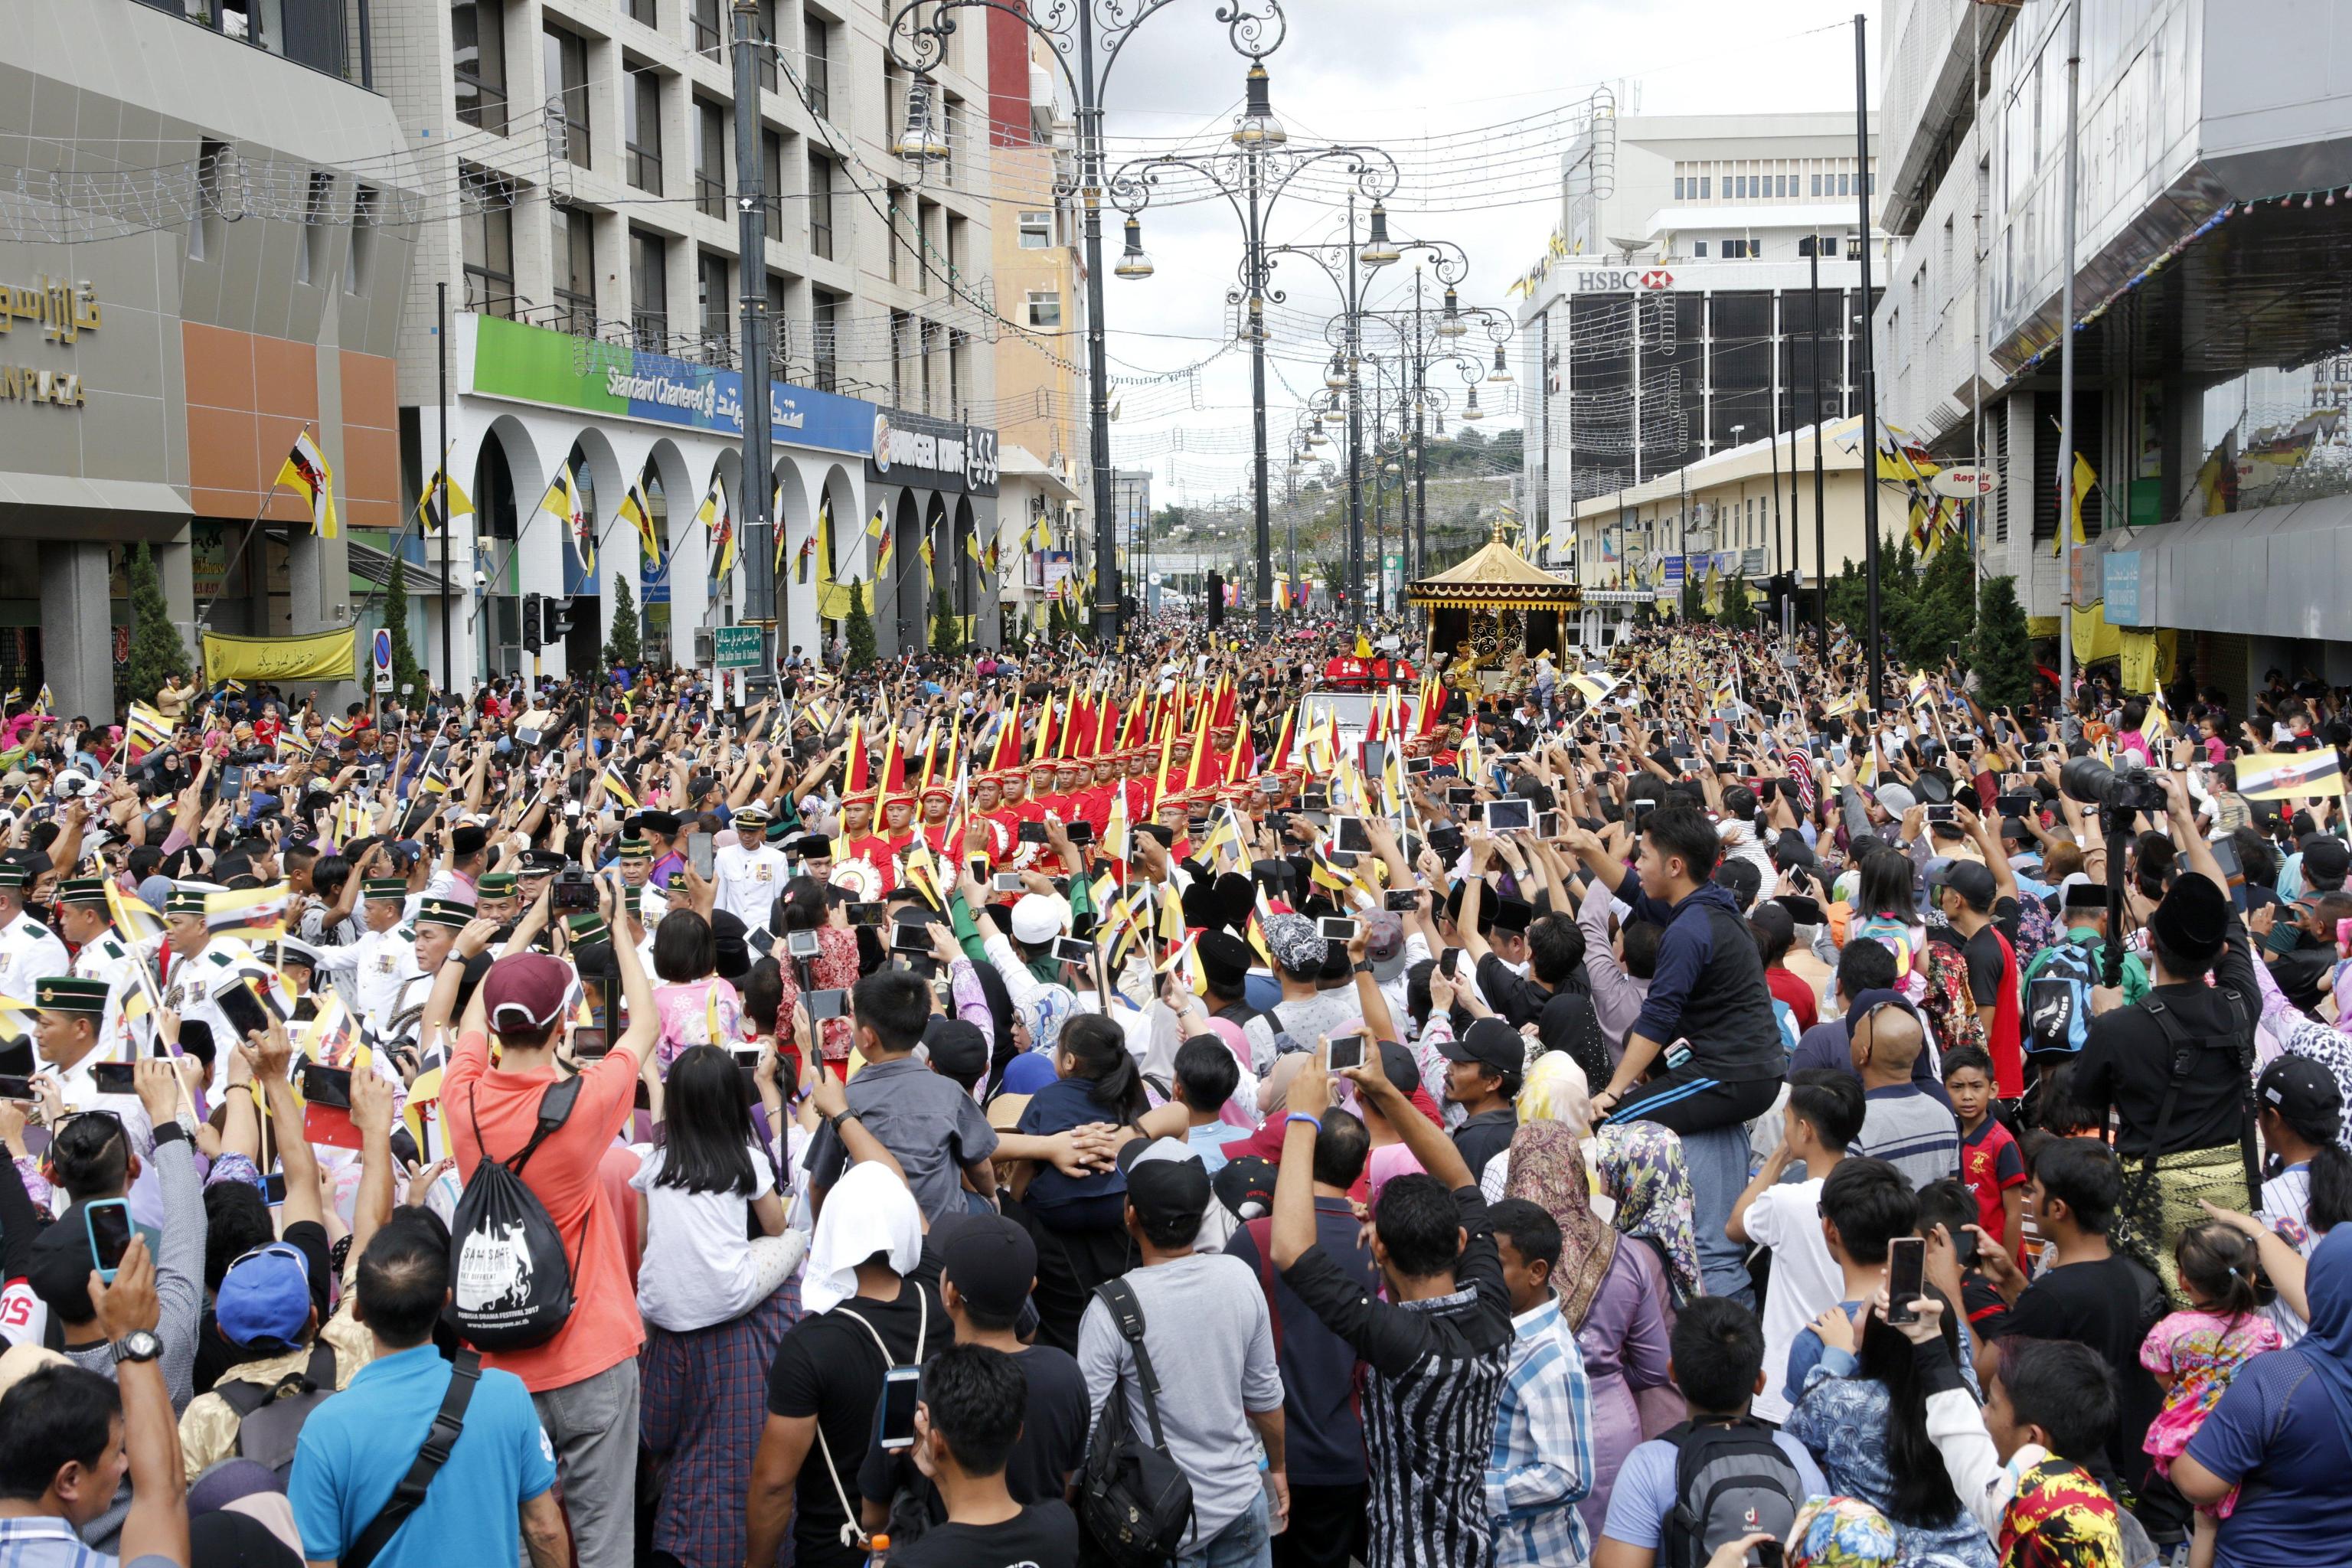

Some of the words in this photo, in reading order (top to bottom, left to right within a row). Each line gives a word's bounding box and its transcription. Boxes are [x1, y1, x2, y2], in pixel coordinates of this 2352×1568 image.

[1578, 271, 1638, 291] HSBC
[24, 368, 86, 406] PLAZA
[606, 366, 655, 402] Standard
[656, 377, 704, 410] Chartered
[890, 428, 937, 469] BURGER
[938, 438, 965, 474] KING
[1953, 473, 1991, 483] Repir
[118, 626, 127, 658] SALE
[2047, 995, 2069, 1037] adidas
[458, 1312, 479, 1320] FOBISIA
[499, 1309, 524, 1318] FESTIVAL
[524, 1305, 539, 1315] 2017
